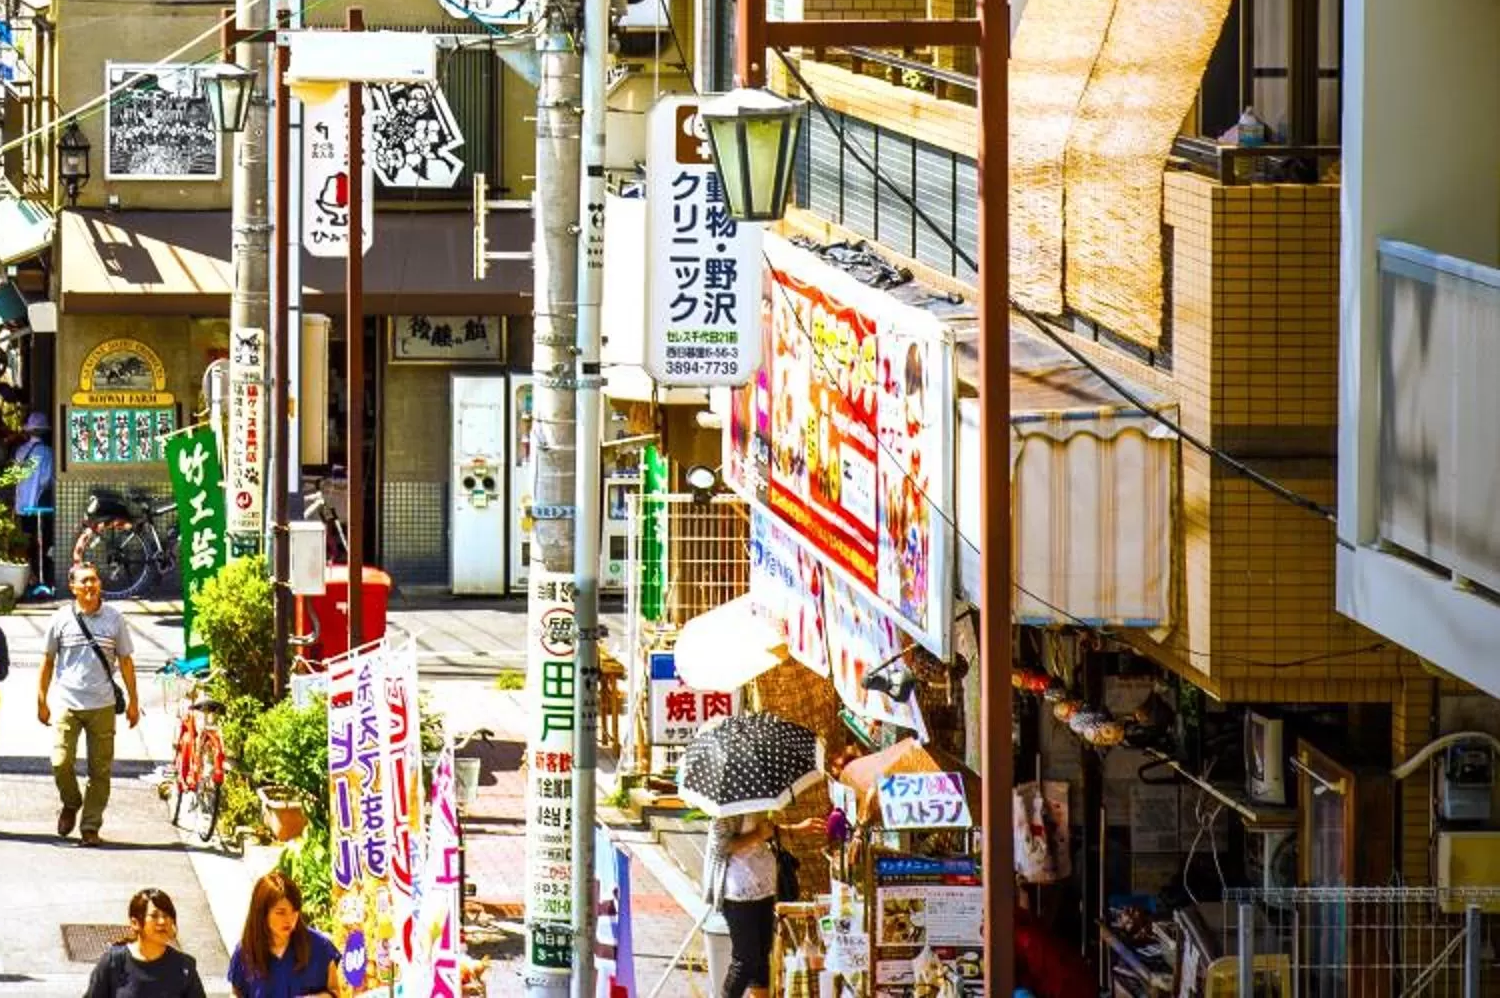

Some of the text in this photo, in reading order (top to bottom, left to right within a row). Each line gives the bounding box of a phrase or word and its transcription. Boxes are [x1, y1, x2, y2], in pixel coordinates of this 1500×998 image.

[668, 170, 701, 324] クリニック
[178, 441, 218, 595] 竹工芸
[665, 690, 732, 722] 焼肉
